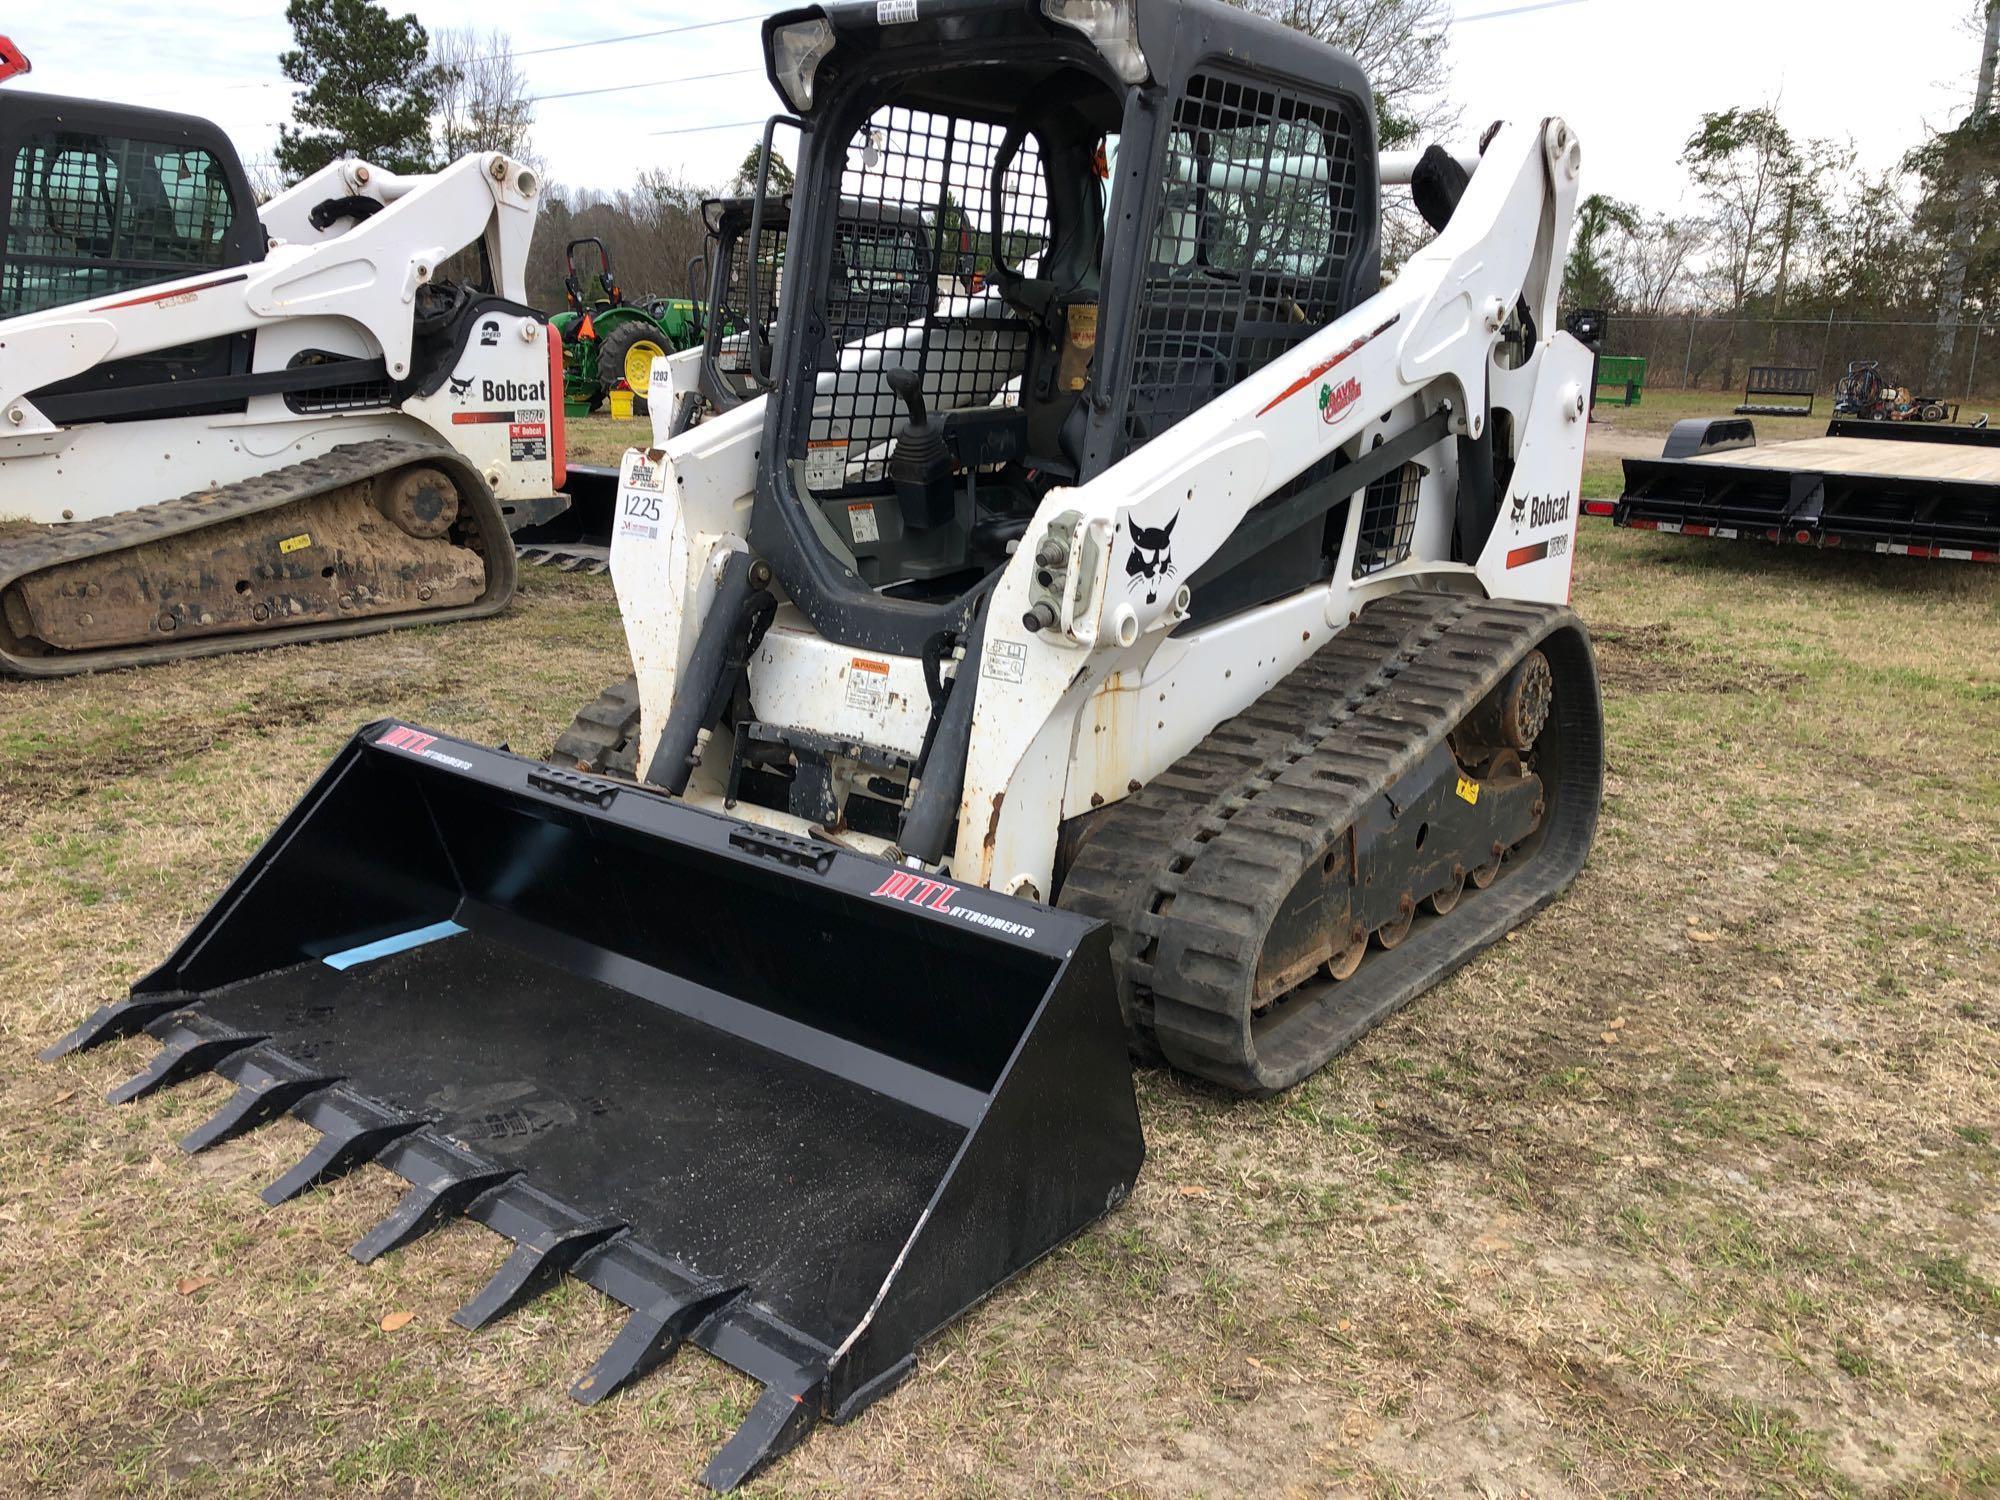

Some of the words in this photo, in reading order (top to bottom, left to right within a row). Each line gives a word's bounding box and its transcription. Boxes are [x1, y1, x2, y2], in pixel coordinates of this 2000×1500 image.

[480, 320, 500, 346] 2
[653, 370, 668, 382] 1203
[482, 379, 546, 402] Bobcat
[517, 409, 546, 424] T870
[521, 426, 542, 436] Bobcat
[624, 494, 663, 521] 1225
[1530, 490, 1570, 528] Bobcat
[869, 869, 961, 914] MTL
[950, 905, 1036, 939] ATTACHMENTS
